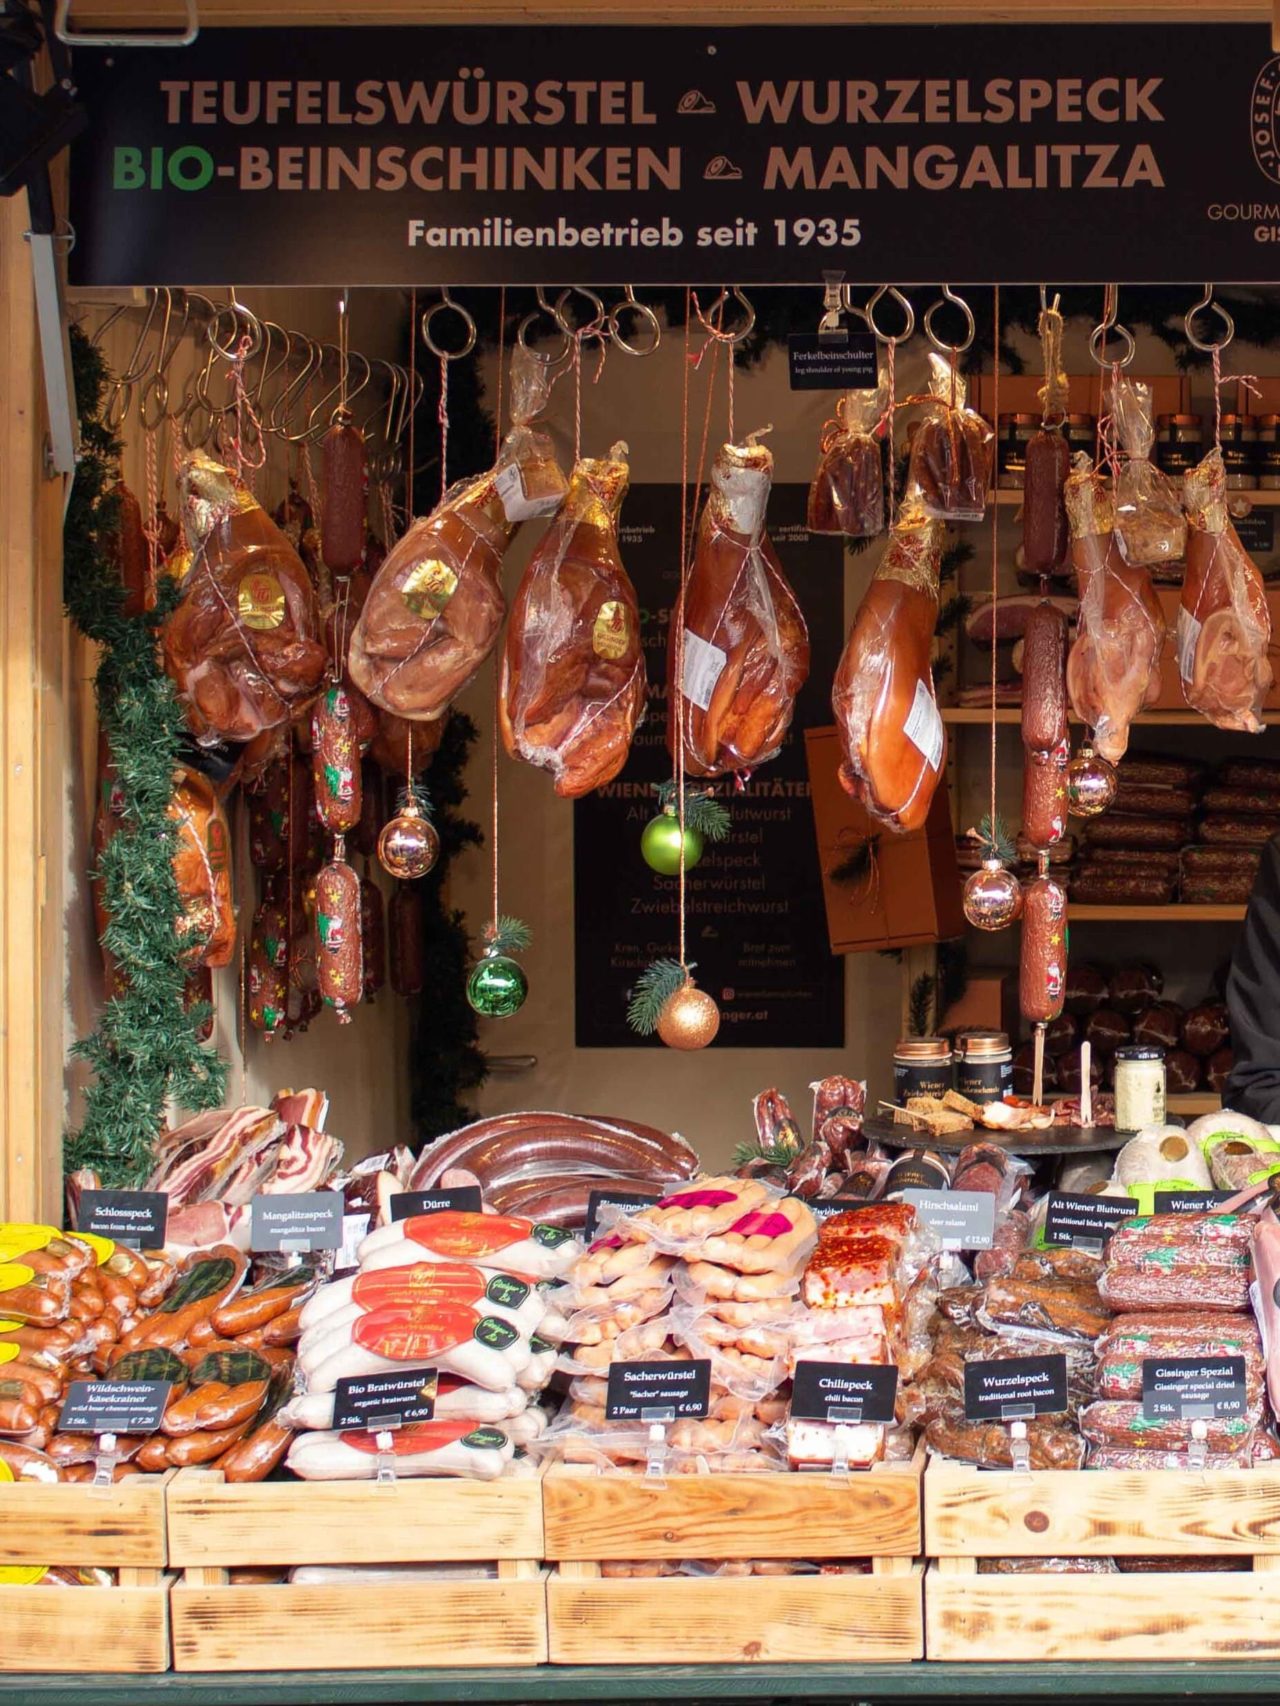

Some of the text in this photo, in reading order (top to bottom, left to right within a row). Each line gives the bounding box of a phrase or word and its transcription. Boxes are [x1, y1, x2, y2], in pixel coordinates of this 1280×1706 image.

[161, 67, 1165, 126] TEUFELSWÜRSTEL WURZELSPECK
[1254, 78, 1275, 159] JOSEF
[112, 144, 1166, 192] BIO-BEINSCHINKEN MANGALITZA
[408, 218, 861, 248] Familienbetrieb seit 1935
[793, 351, 874, 361] Ferkelbeinschulter
[423, 1199, 451, 1210] Dürre
[919, 1200, 979, 1212] Hirschsalami
[1051, 1200, 1137, 1216] Alt Wiener Blutwurst
[1171, 1200, 1206, 1210] Wiener
[95, 1207, 152, 1220] Schlossspeck
[263, 1209, 333, 1222] Mangalitzaspeck
[1052, 1217, 1103, 1228] traditional black
[972, 1235, 990, 1245] 12,90
[624, 1370, 696, 1382] Sacherwürstel
[1156, 1366, 1234, 1379] Gissinger Spezial
[819, 1378, 873, 1391] Chilispeck
[983, 1372, 1050, 1388] Wurzelspeck
[1155, 1380, 1235, 1391] Gissinger special dried
[86, 1384, 155, 1393] Wildschwein-
[348, 1378, 426, 1395] Bio Bratwürstel
[87, 1394, 147, 1403] käsekrainer
[660, 1390, 688, 1399] sausage
[824, 1394, 864, 1403] chili bacon
[978, 1388, 1055, 1401] traditional root bacon
[1181, 1391, 1210, 1400] sausage
[411, 1408, 428, 1417] 6,90
[620, 1406, 637, 1415] Paar
[685, 1403, 702, 1412] 6,90
